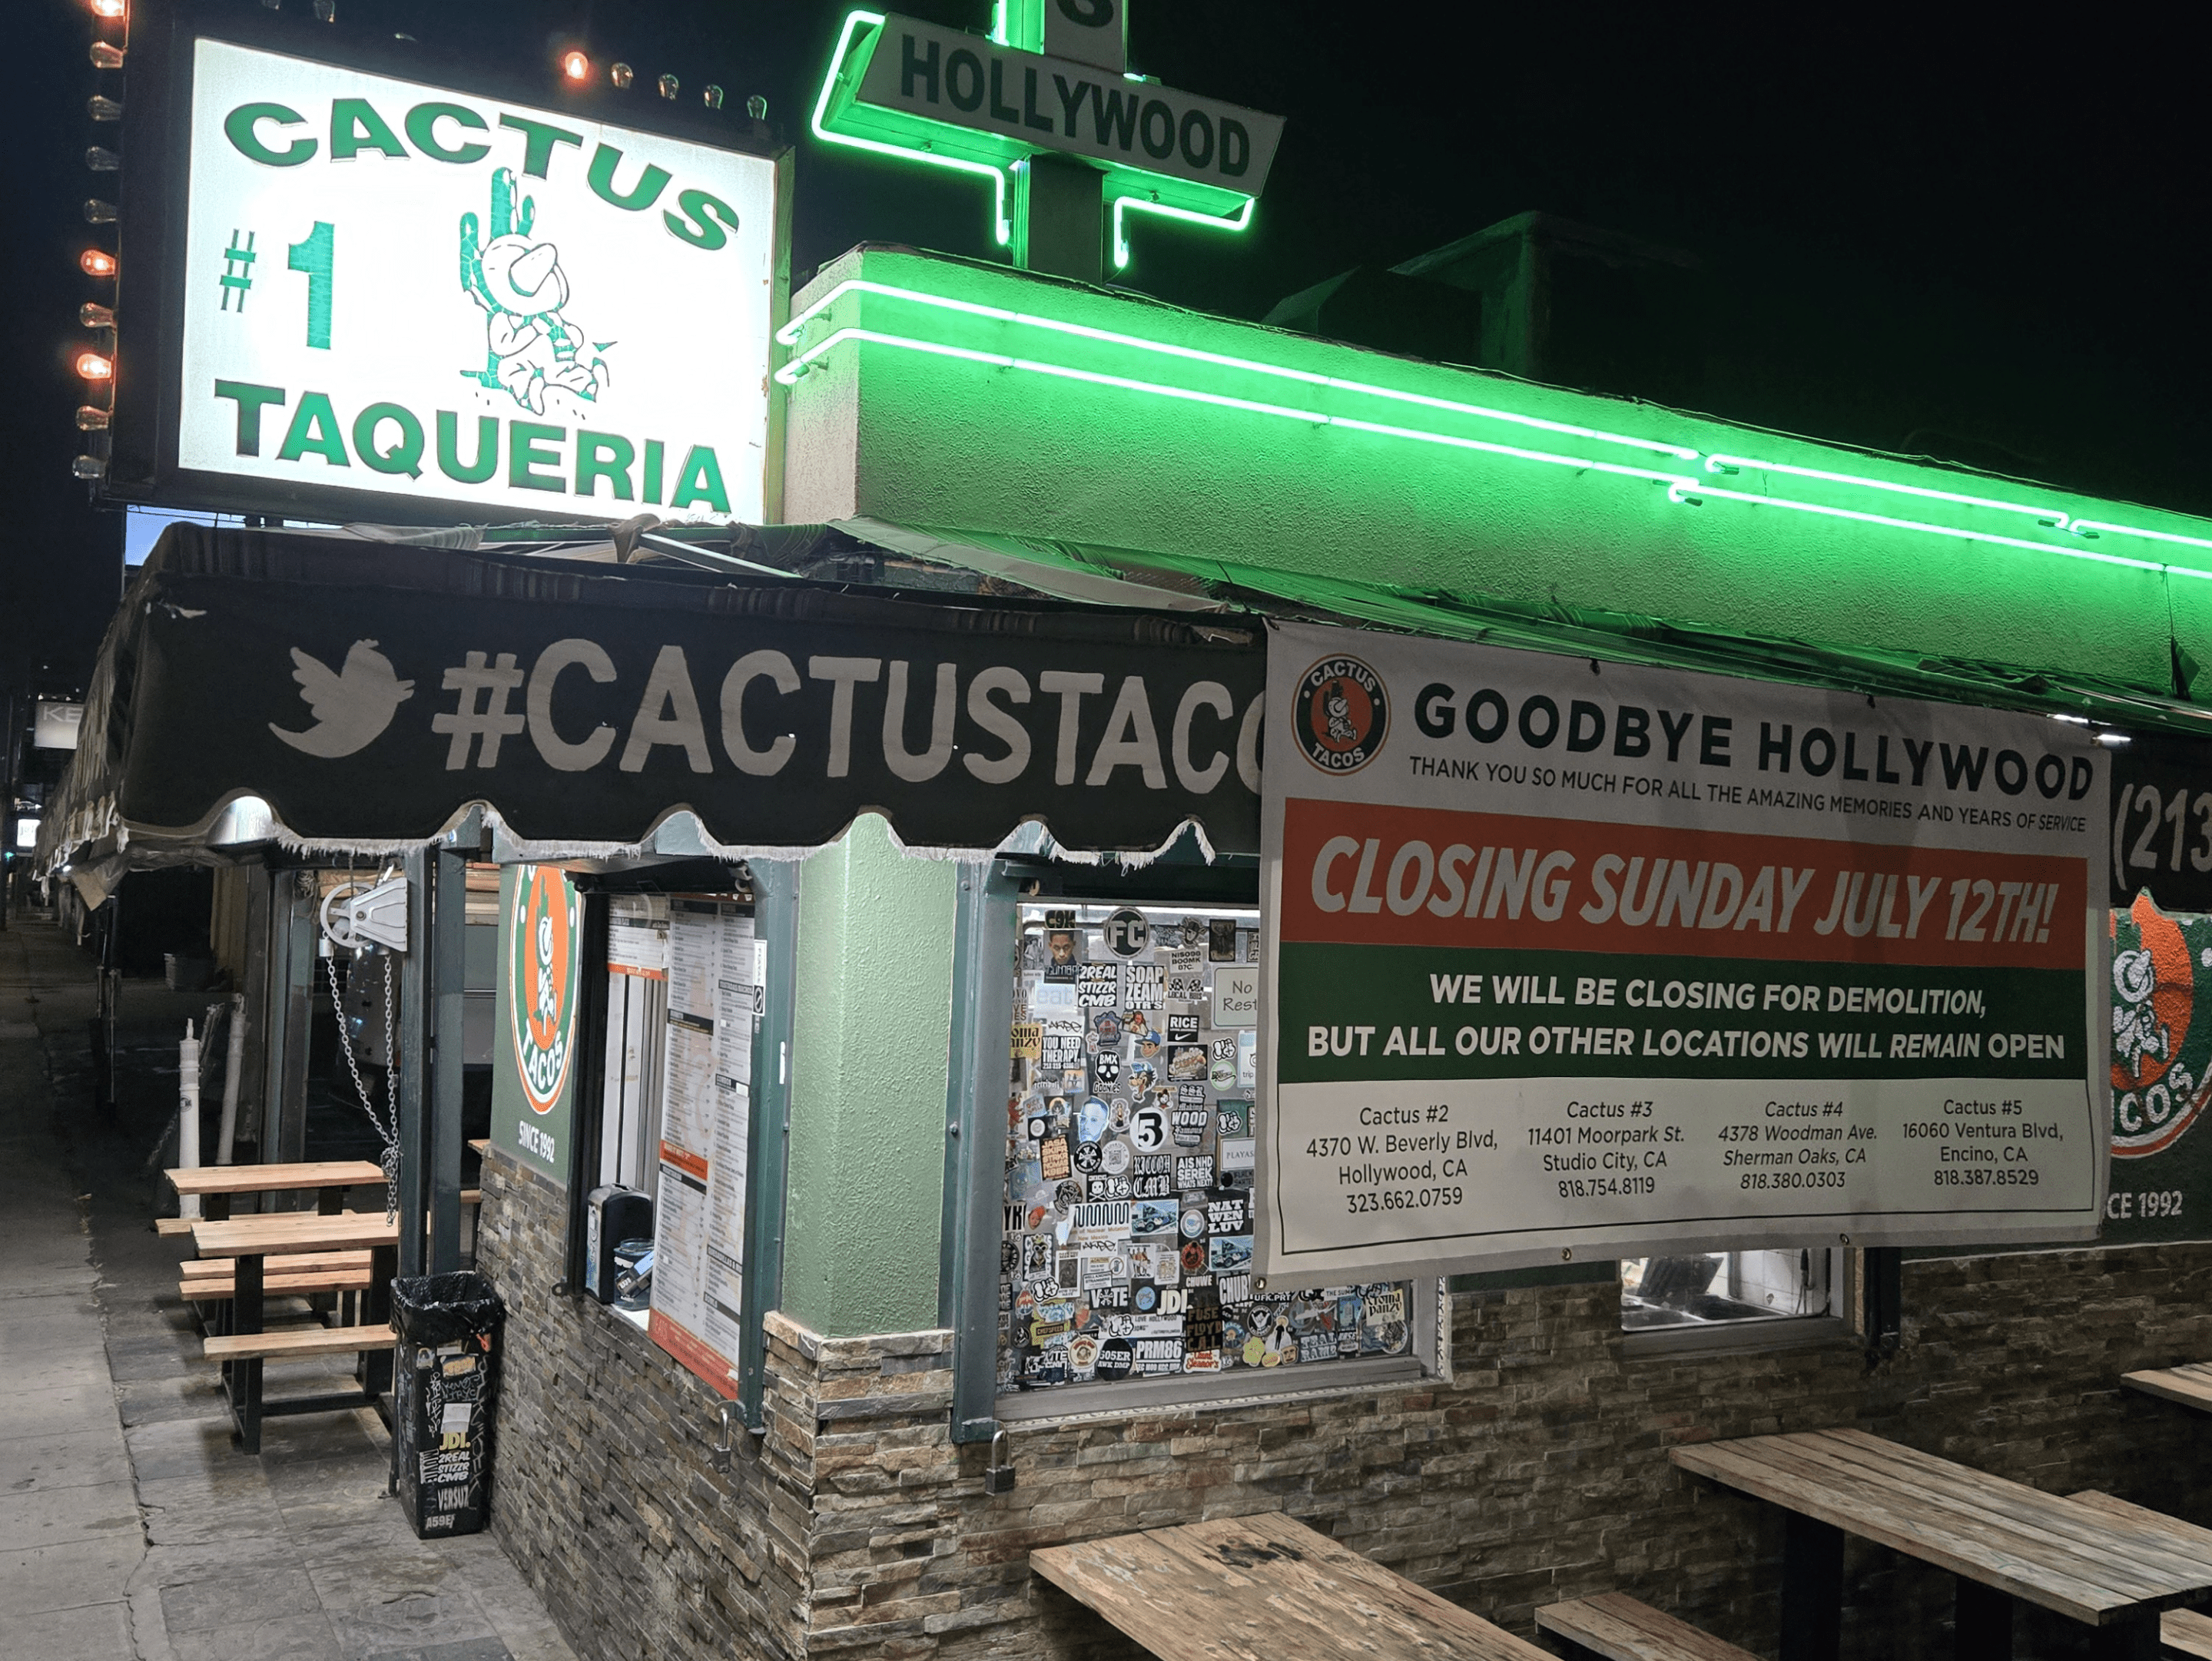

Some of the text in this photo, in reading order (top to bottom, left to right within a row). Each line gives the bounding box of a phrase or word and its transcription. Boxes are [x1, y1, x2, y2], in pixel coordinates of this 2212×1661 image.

[900, 33, 1250, 177] HOLLYWOOD
[224, 97, 740, 251] CACTUS
[214, 379, 732, 515] TAQUERIA
[1310, 660, 1378, 693] CACTUS
[1414, 682, 2094, 801] GOODBYE HOLLYWOOD
[1311, 741, 1365, 768] TACOS
[1409, 755, 2087, 834] THANK YOU SO MUCH FOR ALL THE AMAZING MEMORIES AND YEARS OF SERVICE
[2113, 782, 2212, 891] (213
[1311, 834, 2060, 945] CLOSING SUNDAY JULY 12TH!
[1108, 920, 1145, 948] FC
[1079, 966, 1117, 980] 2REAL
[1126, 966, 1164, 983] SOAP
[1126, 983, 1163, 1001] ZEAM
[1232, 980, 1252, 994] No
[1429, 973, 1987, 1019] WE WILL BE CLOSING FOR DEMOLITION,
[1078, 994, 1116, 1007] CMB
[1223, 998, 1258, 1012] Rest
[1169, 1016, 1198, 1029] RICE
[1042, 1036, 1059, 1049] YOU
[1060, 1036, 1081, 1049] NEED
[1308, 1026, 2065, 1059] BUT ALL OUR OTHER LOCATIONS WILL REMAIN OPEN
[523, 1018, 563, 1089] TACOS
[1099, 1054, 1118, 1065] BMX
[1943, 1098, 2023, 1117] Cactus #5
[2111, 1062, 2193, 1133] COS
[1358, 1105, 1450, 1126] Cactus #2
[1566, 1100, 1653, 1119] Cactus #3
[1765, 1099, 1844, 1119] Cactus #4
[1172, 1112, 1208, 1127] WOOD
[519, 1119, 555, 1163] SINCE 1992
[1527, 1123, 1685, 1149] 11401 Moorpark St.
[1718, 1122, 1879, 1142] 4378 Woodman Ave.
[1902, 1121, 2064, 1142] 16060 Ventura Blvd,
[1306, 1129, 1499, 1158] 4370 W. Beverly Blvd,
[1178, 1155, 1213, 1169] AIS NHD
[1544, 1150, 1668, 1174] Studio City, CA
[1723, 1147, 1868, 1168] Sherman Oaks, CA
[1939, 1145, 2029, 1165] Encino, CA
[1177, 1168, 1213, 1180] SEREK
[1339, 1159, 1469, 1186] Hollywood, CA
[1739, 1171, 1846, 1191] 818.380.0303
[1933, 1169, 2040, 1187] 818.387.8529
[1557, 1175, 1656, 1199] 818.754.8119
[1208, 1199, 1244, 1212] NAT
[1347, 1186, 1464, 1214] 323.662.0759
[2138, 1190, 2184, 1219] 1992
[1208, 1210, 1244, 1222] WEN
[1208, 1220, 1244, 1234] LUV
[1219, 1274, 1251, 1305] CHUB
[1188, 1307, 1219, 1321] FUSE
[1136, 1340, 1182, 1359] PRM86
[438, 1450, 471, 1464] 2REAL
[437, 1471, 469, 1484] CMB
